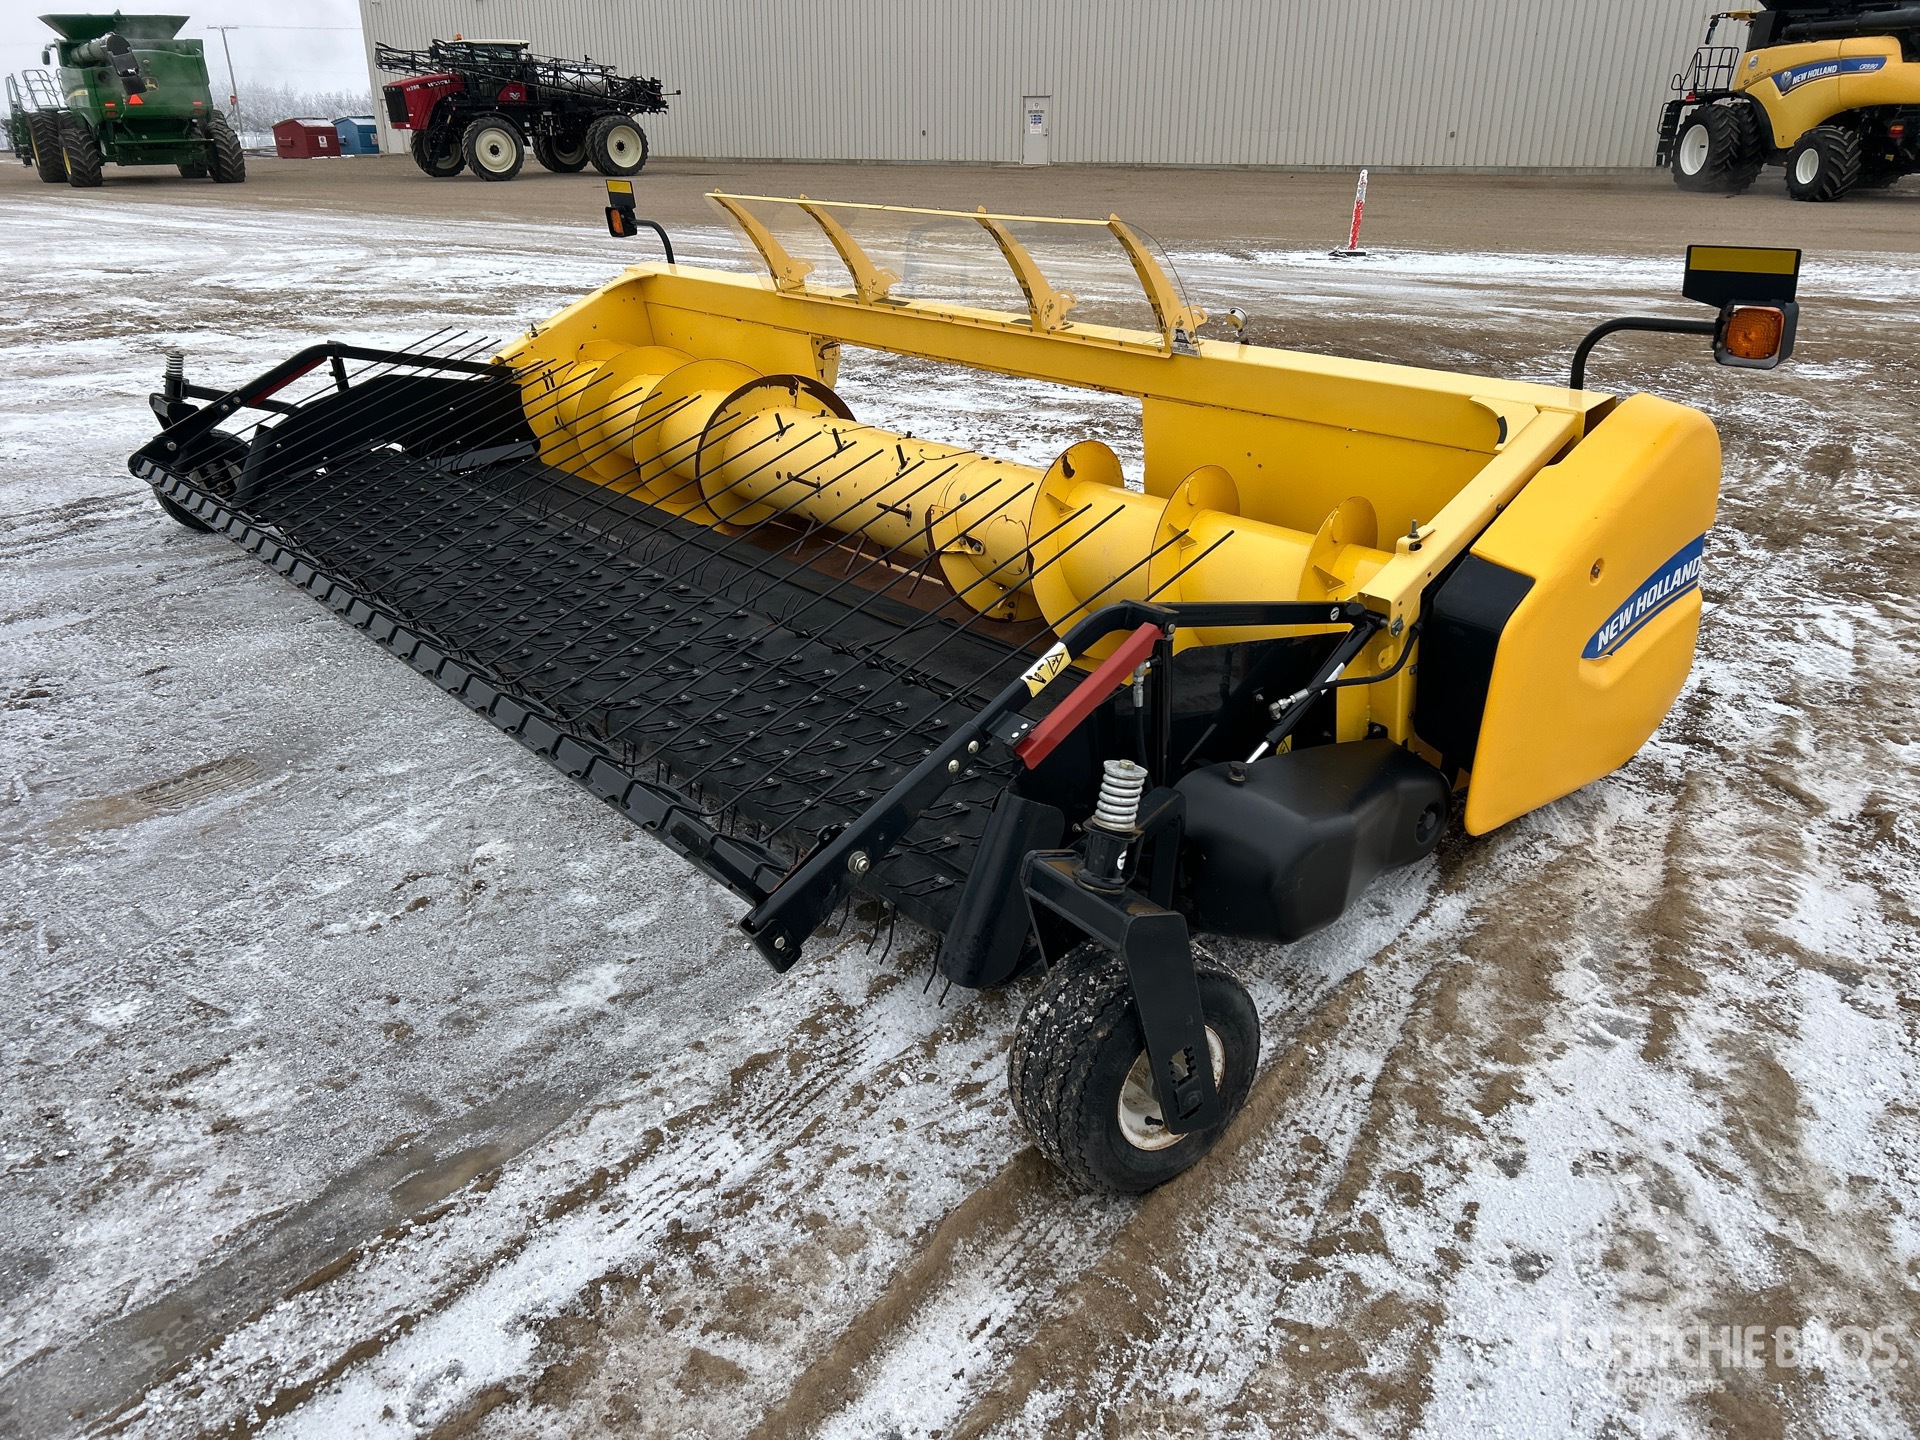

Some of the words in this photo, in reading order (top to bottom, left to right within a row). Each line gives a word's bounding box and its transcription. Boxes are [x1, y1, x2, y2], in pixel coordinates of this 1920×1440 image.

[1792, 73, 1808, 85] NEW
[1808, 65, 1837, 79] HOLLAND
[1597, 602, 1635, 652] NEW
[1635, 555, 1702, 618] HOLLAND
